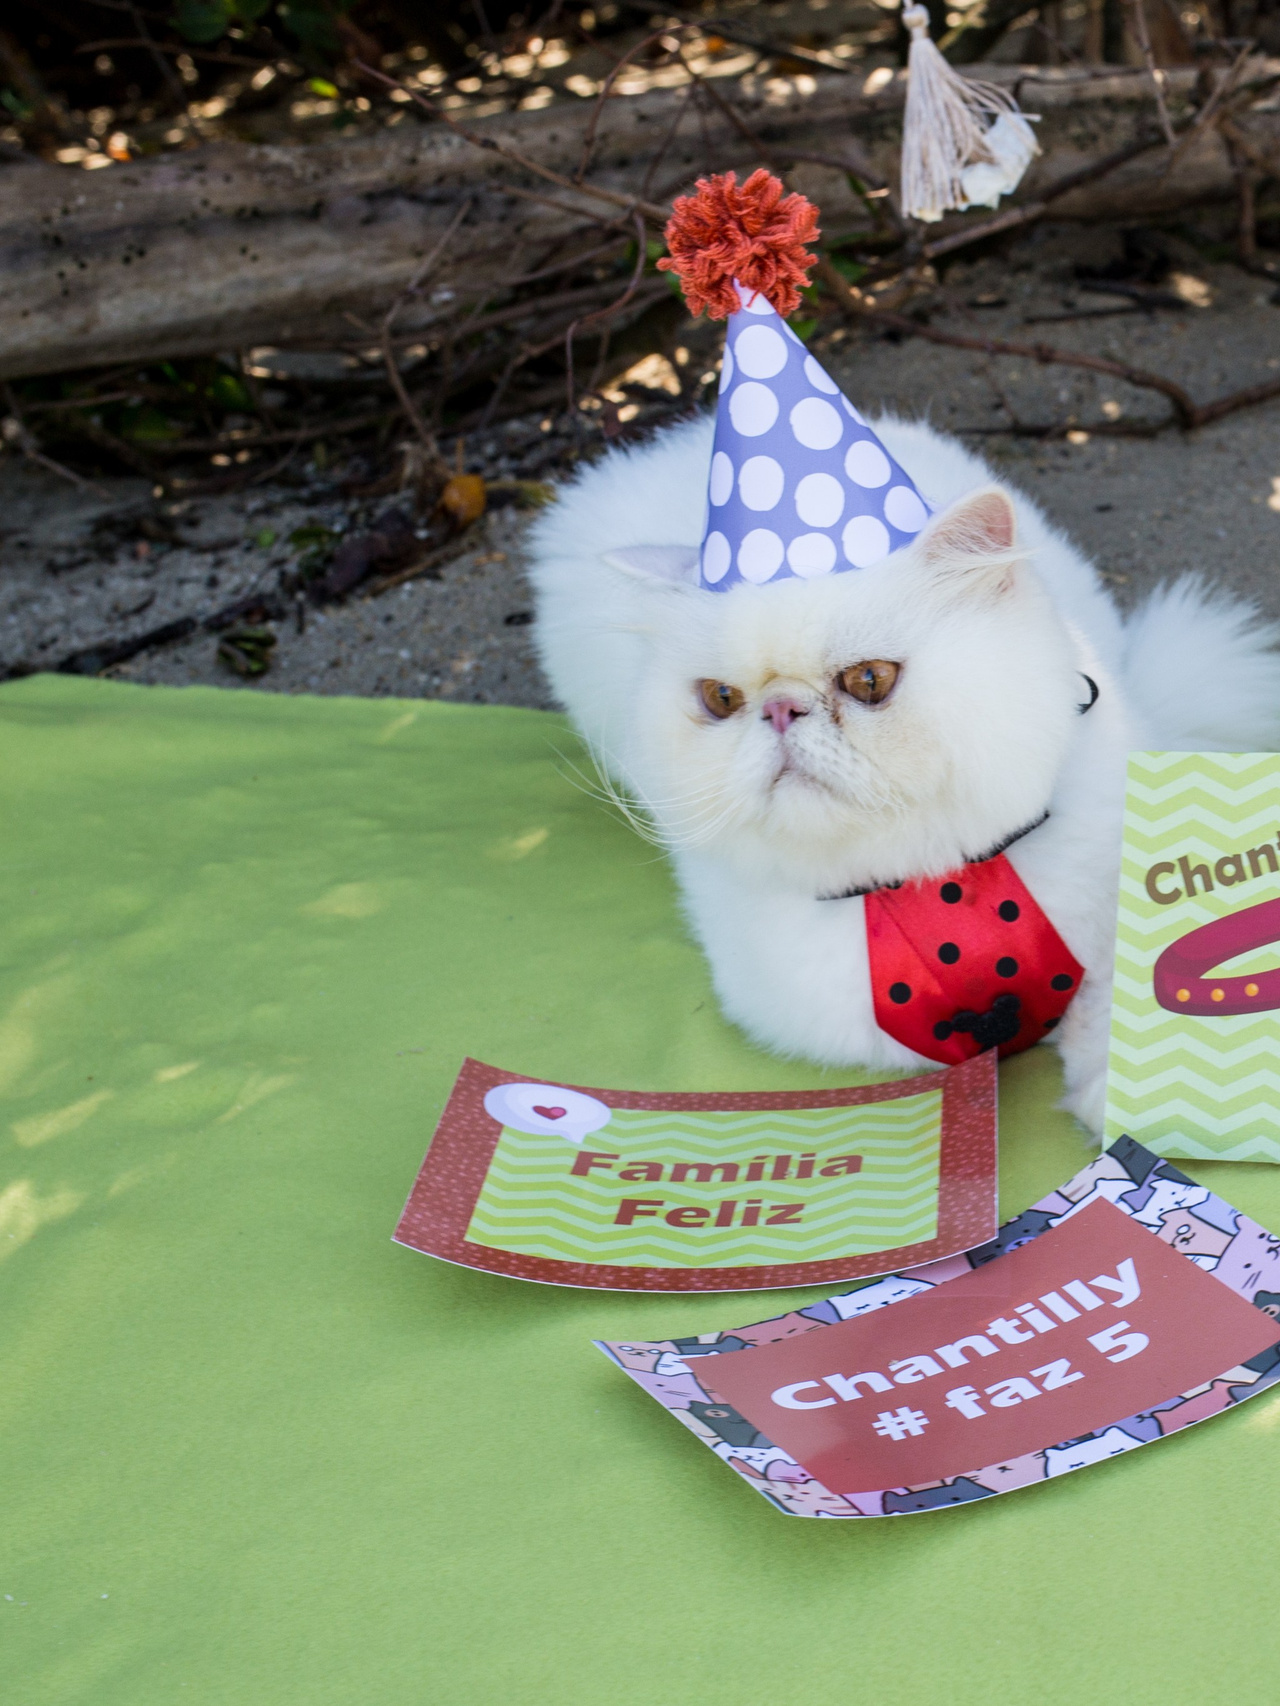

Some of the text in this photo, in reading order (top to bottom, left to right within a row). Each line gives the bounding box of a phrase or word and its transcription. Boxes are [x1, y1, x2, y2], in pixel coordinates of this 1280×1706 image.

[570, 1150, 863, 1183] Família
[613, 1198, 806, 1228] Feliz
[770, 1257, 1142, 1411] Chantilly
[945, 1357, 1086, 1420] faz
[1086, 1320, 1150, 1364] 5
